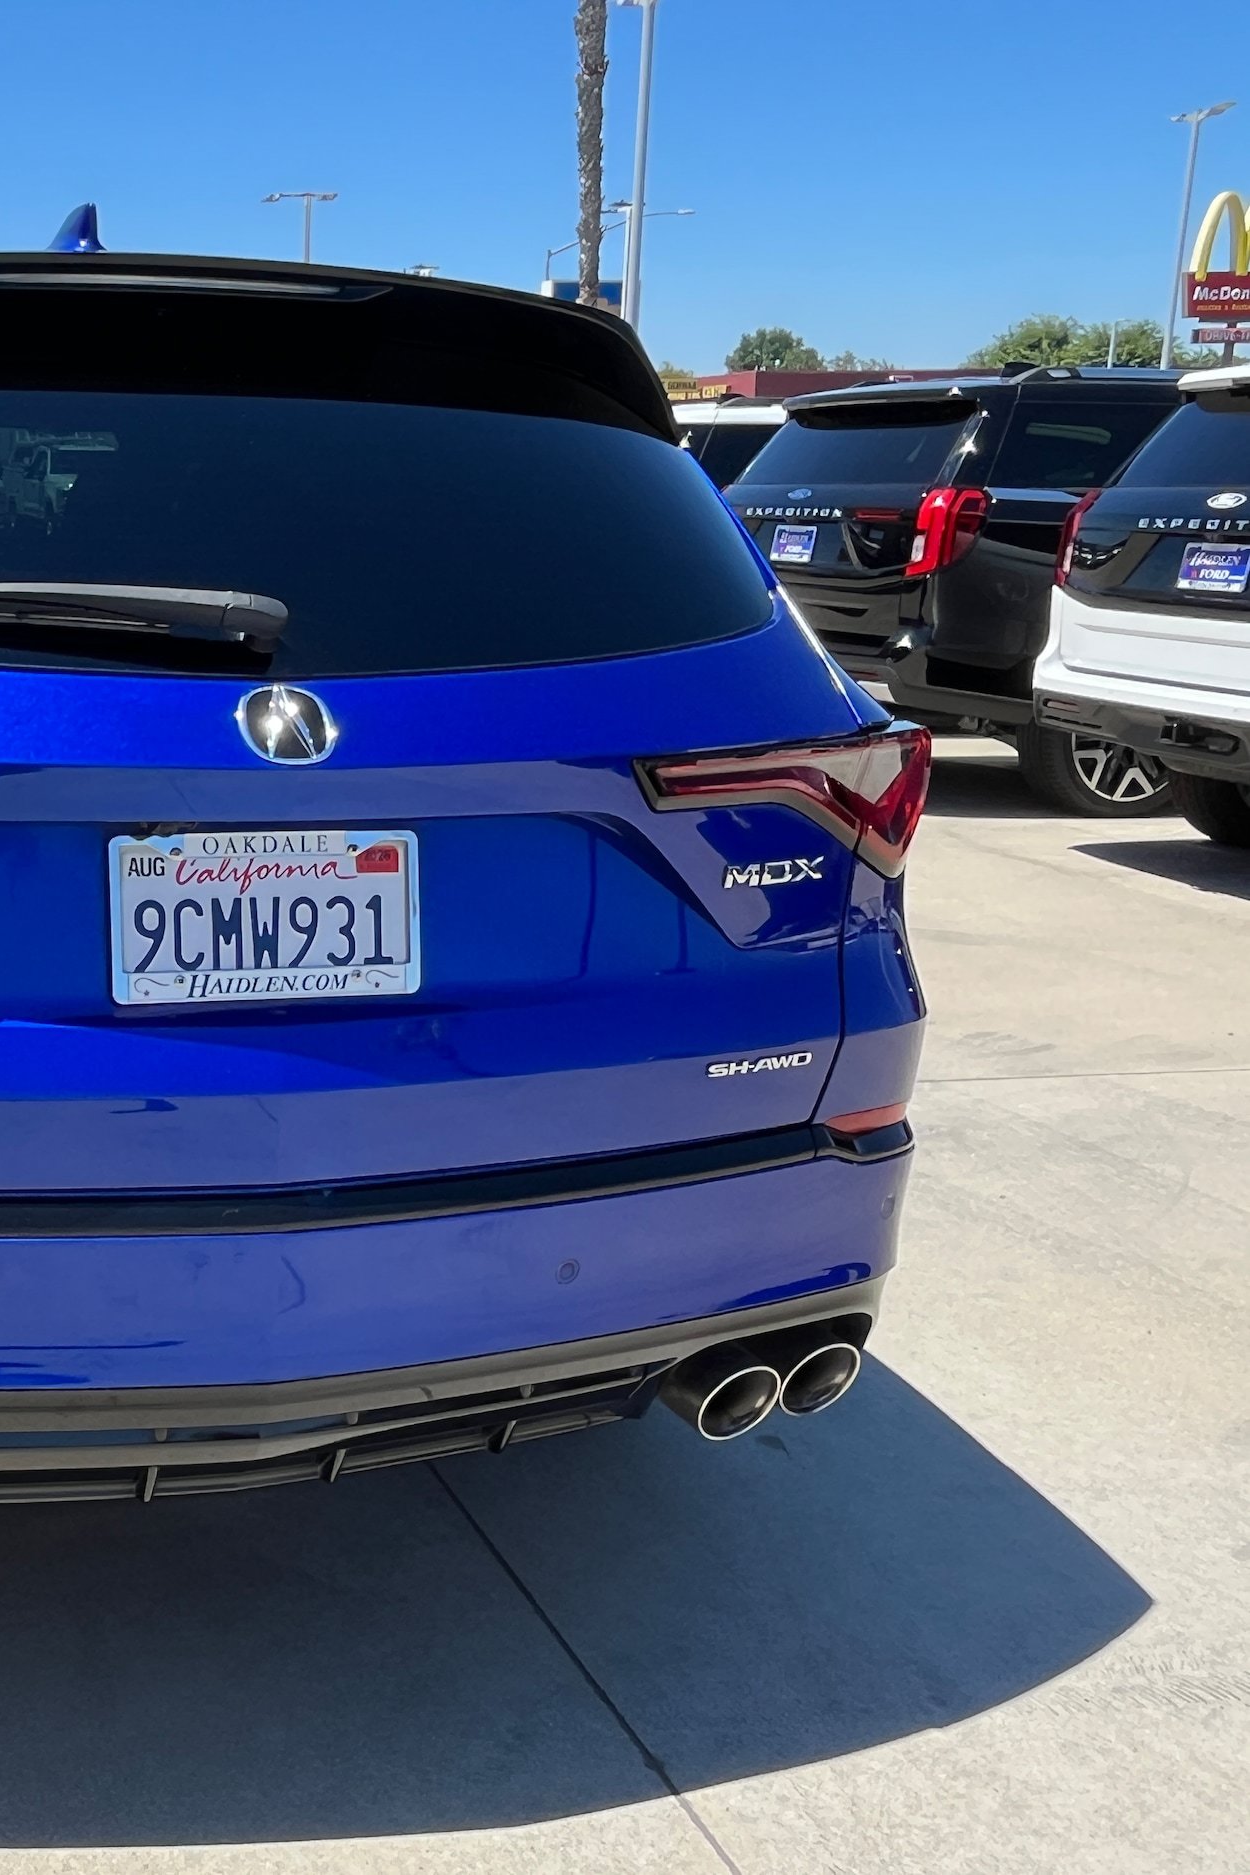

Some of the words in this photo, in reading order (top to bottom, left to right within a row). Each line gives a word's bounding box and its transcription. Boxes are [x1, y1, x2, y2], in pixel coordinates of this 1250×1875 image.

[746, 506, 843, 518] EXPEDITION
[1137, 517, 1250, 531] EXPEDIT
[1199, 568, 1230, 580] FORD
[202, 834, 329, 856] OAKDALE
[128, 857, 166, 877] AUG
[175, 857, 357, 895] California
[723, 855, 825, 889] MDX
[133, 894, 394, 973] 9CMW931
[186, 973, 349, 998] HAIDLEN.COM
[707, 1052, 813, 1078] SH-AWD
